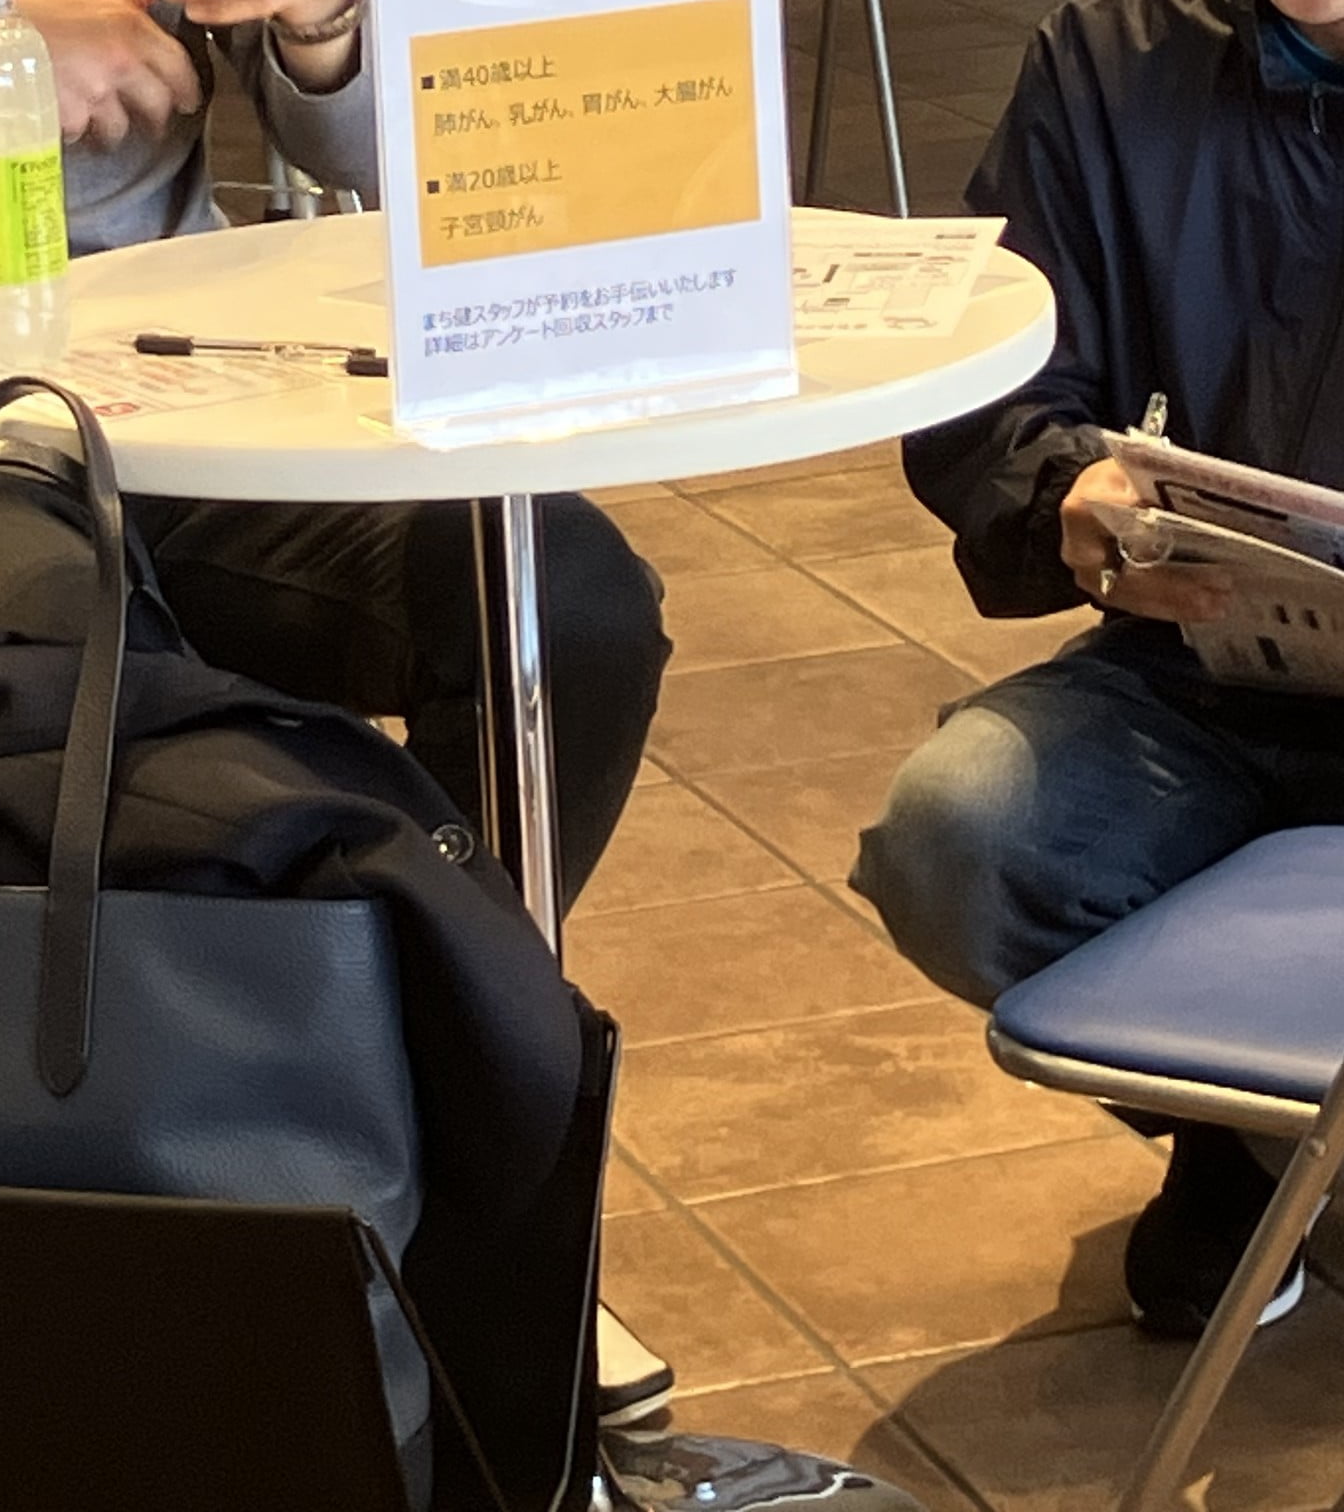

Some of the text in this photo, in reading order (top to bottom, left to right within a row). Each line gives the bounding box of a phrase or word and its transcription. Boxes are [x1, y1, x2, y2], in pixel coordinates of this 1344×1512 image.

[440, 55, 557, 91] 満40歳以上
[445, 159, 563, 194] 満20歳以上
[440, 205, 545, 240] 子宮頸がん
